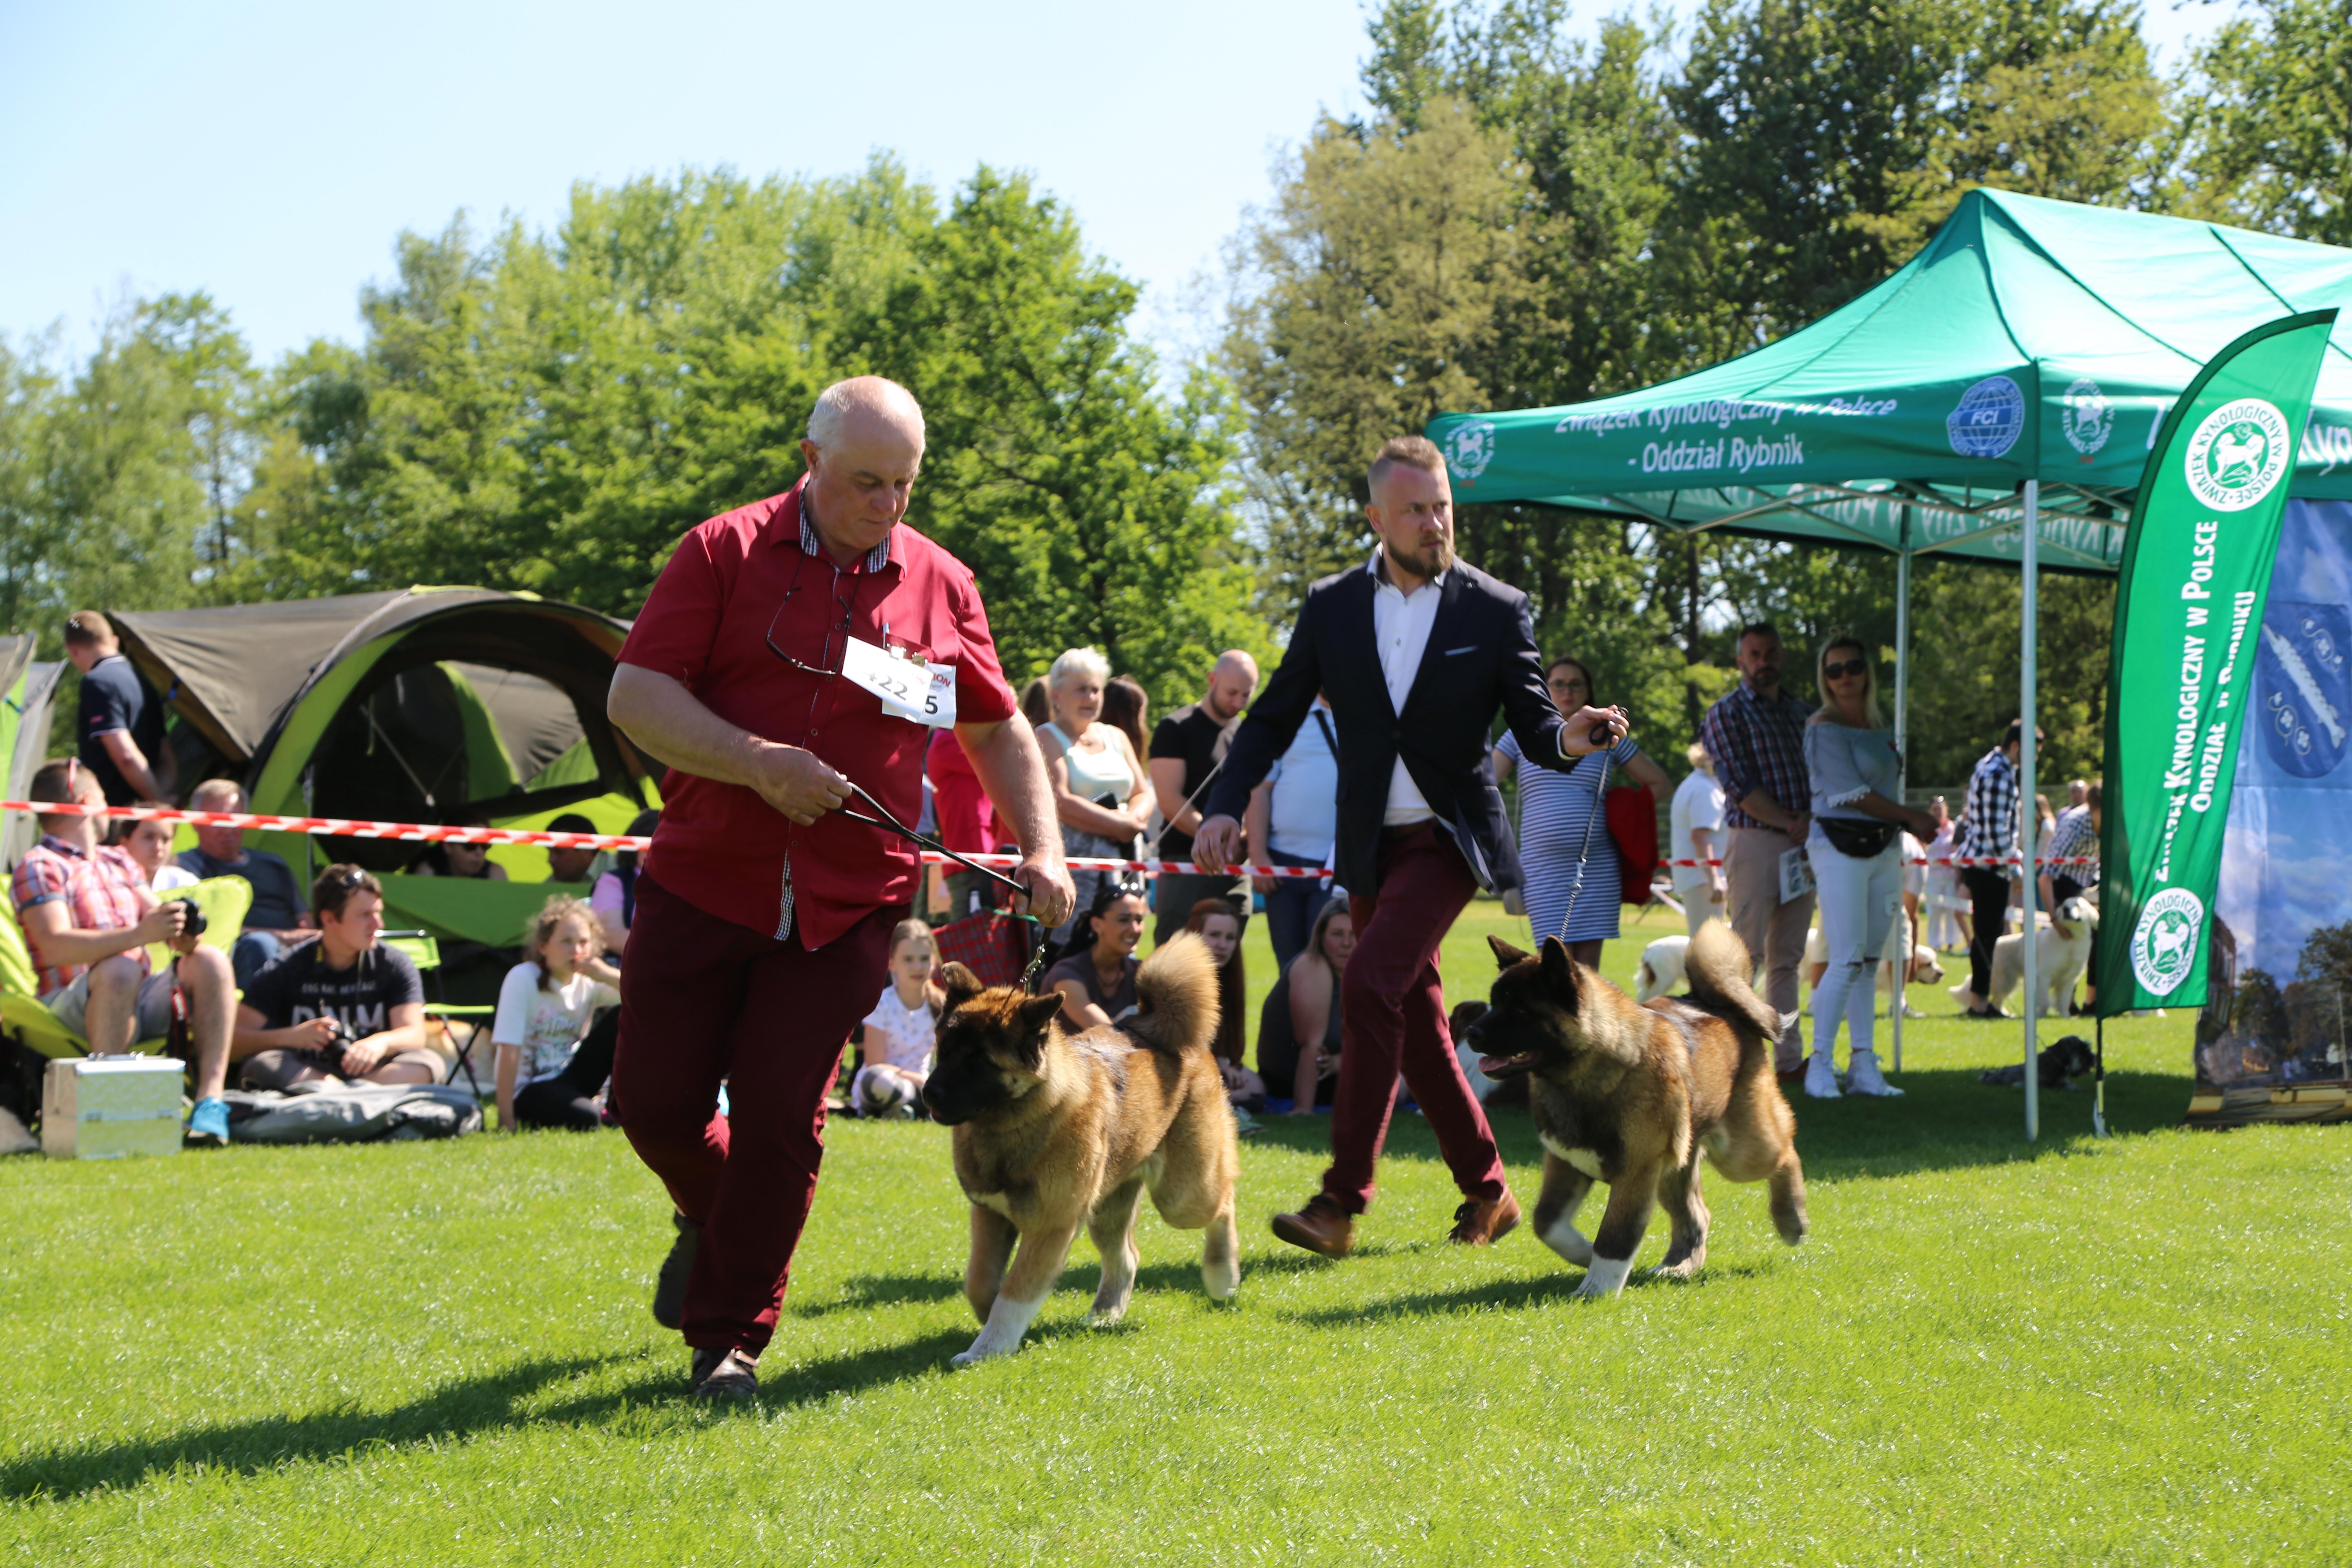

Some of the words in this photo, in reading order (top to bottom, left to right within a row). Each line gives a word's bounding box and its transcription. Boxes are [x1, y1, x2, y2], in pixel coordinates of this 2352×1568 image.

[1555, 408, 1644, 437] Związek
[1647, 399, 1795, 433] Kynologiczny
[1817, 394, 1898, 416] Polsce
[1971, 410, 1999, 425] FCI
[2196, 405, 2283, 447] KYNOLOGICZNY
[1642, 437, 1724, 473] Oddział
[1728, 432, 1804, 474] Rybnik
[2272, 442, 2283, 457] W
[2236, 462, 2278, 504] POLSCE
[2163, 634, 2206, 789] KYNOLOGICZNY
